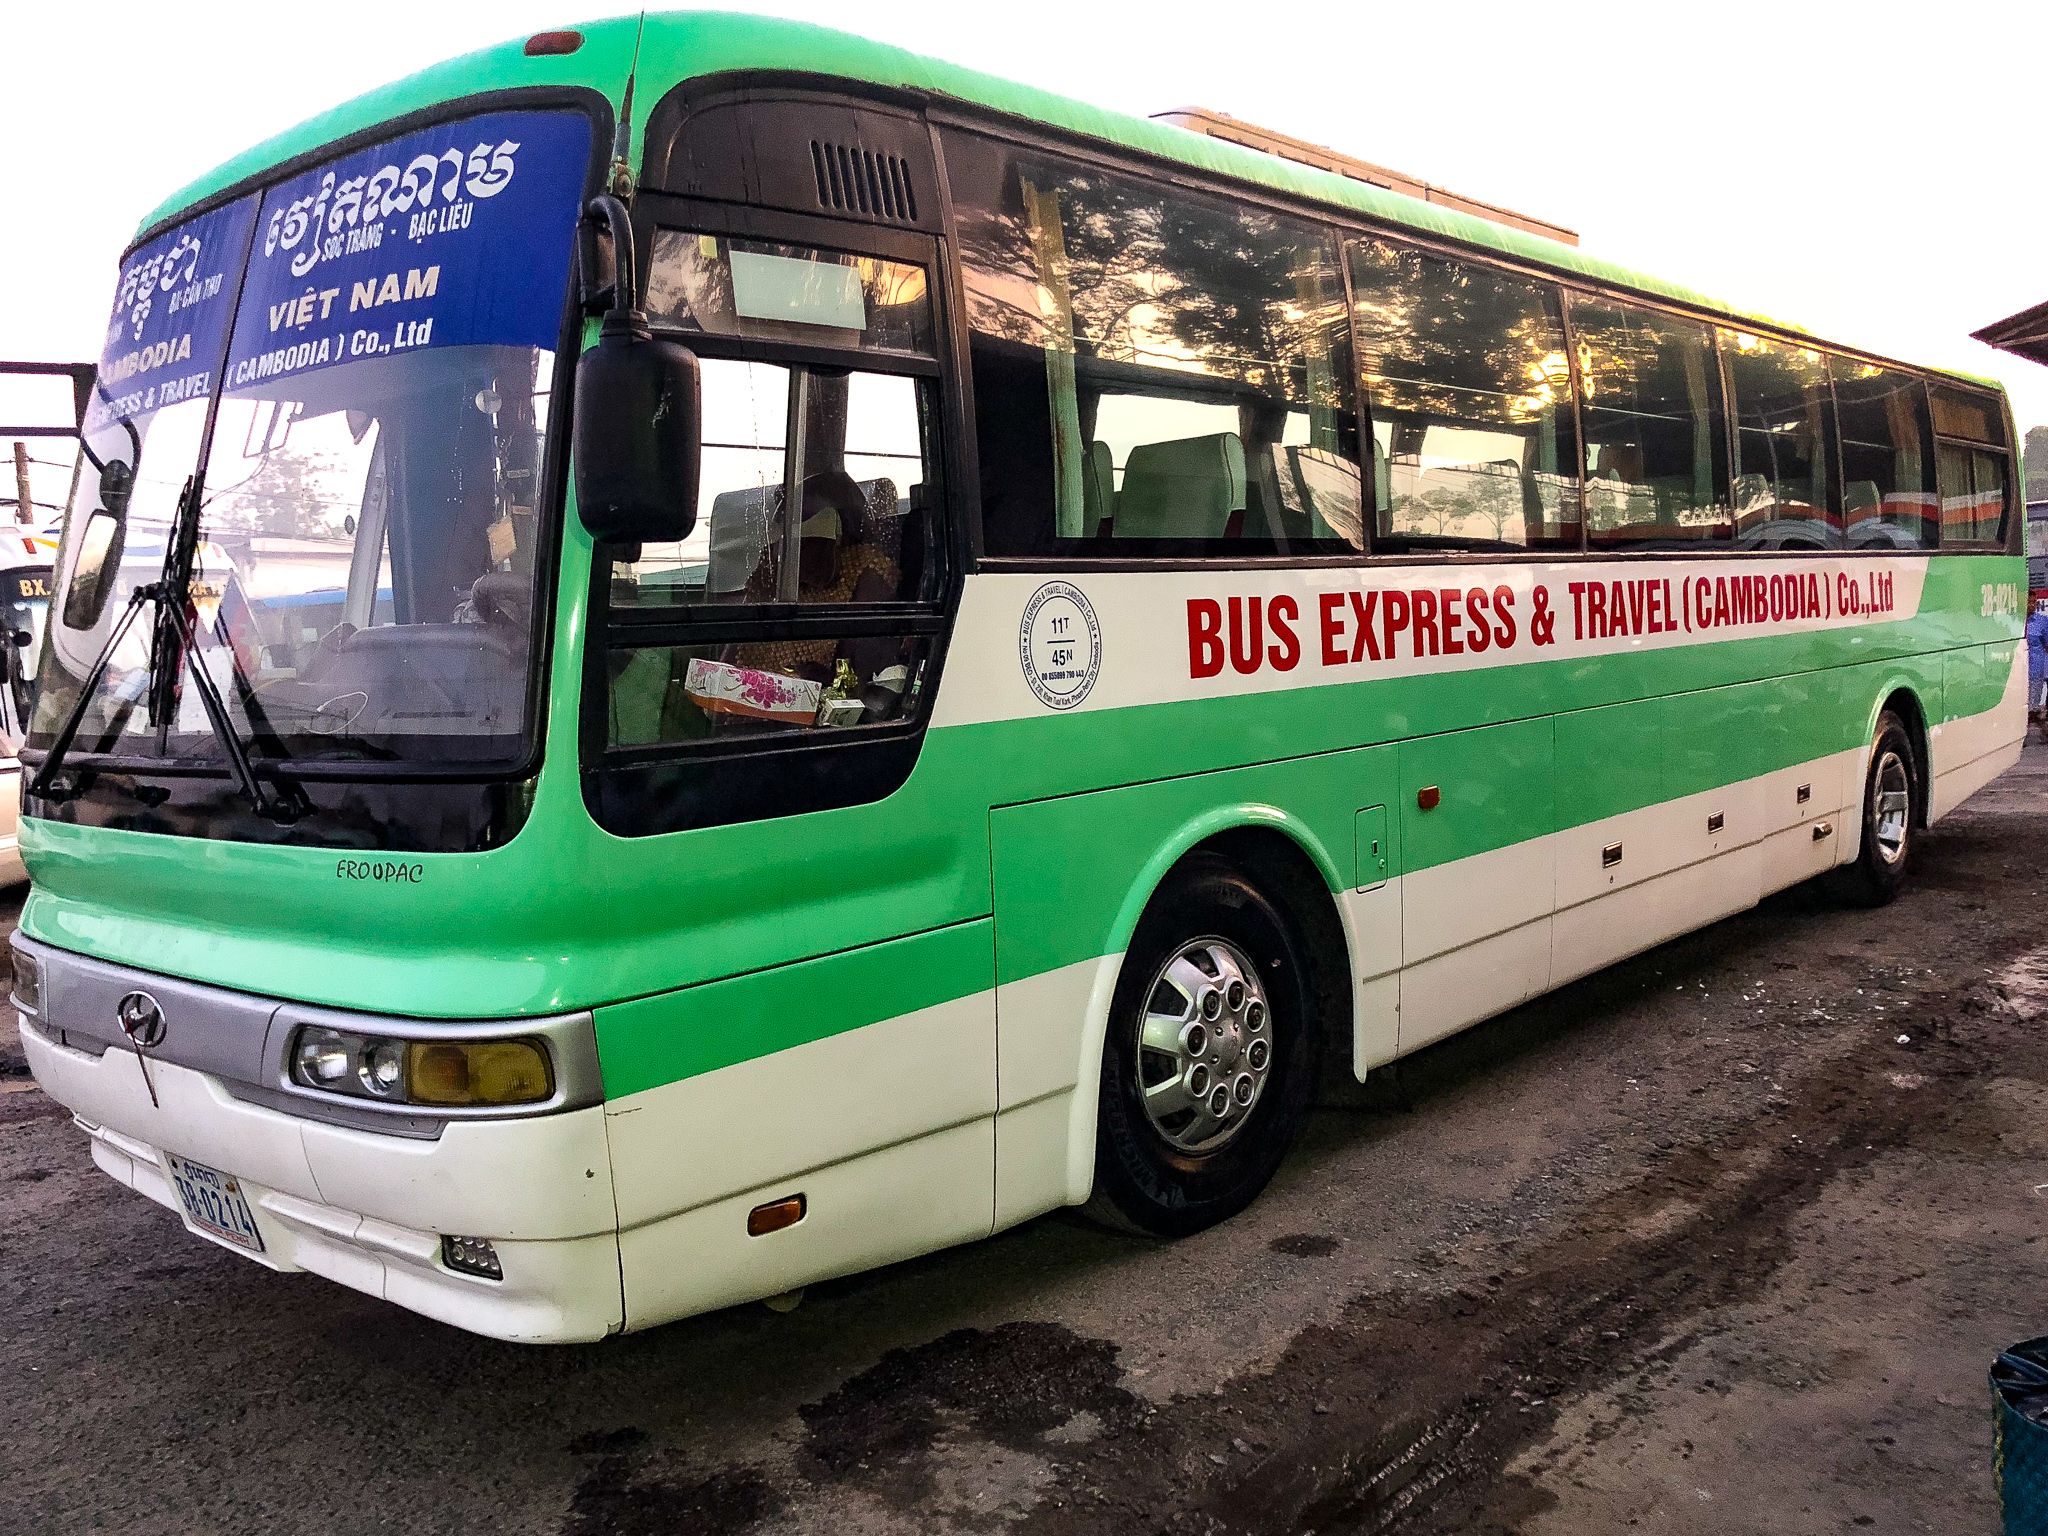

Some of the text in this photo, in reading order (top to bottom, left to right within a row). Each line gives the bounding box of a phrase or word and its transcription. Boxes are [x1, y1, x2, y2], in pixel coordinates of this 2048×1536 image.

[408, 208, 437, 244] BẠC
[269, 286, 340, 332] VIỆT
[350, 265, 440, 313] NAM
[159, 371, 211, 405] TRAVEL
[1187, 595, 1301, 679] BUS
[1319, 584, 1517, 667] EXPRESS
[1530, 584, 1555, 647] &
[1569, 579, 1678, 641] TRAVEL
[336, 859, 423, 883] EROUPAC
